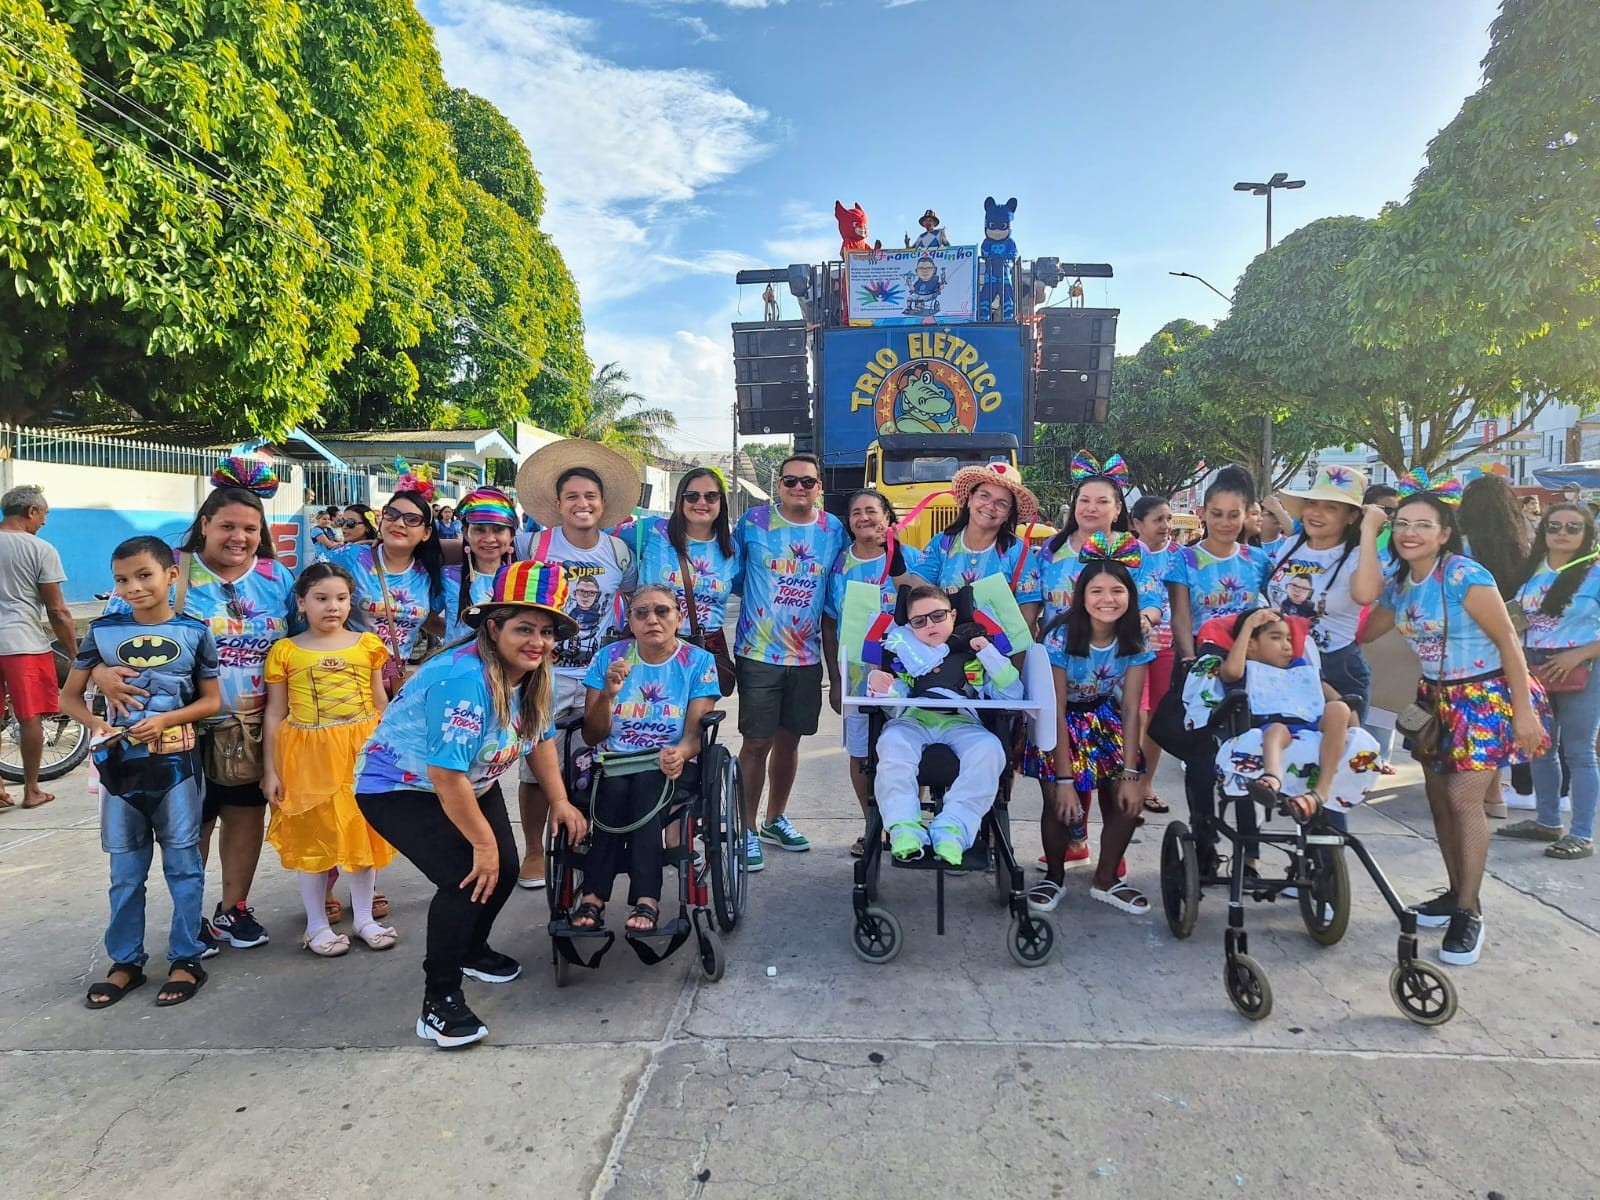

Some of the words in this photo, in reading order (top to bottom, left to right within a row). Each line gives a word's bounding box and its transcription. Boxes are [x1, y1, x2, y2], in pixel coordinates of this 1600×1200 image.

[851, 348, 898, 412] TRIO
[567, 565, 606, 582] SUPER
[777, 576, 817, 590] SOMOS
[676, 589, 719, 605] SMOS
[779, 585, 813, 600] TODOS
[773, 595, 811, 609] RAROS
[451, 707, 484, 725] SOMOS
[452, 716, 480, 731] TODOS
[620, 721, 678, 734] SOMOS
[427, 1013, 446, 1031] FILA
